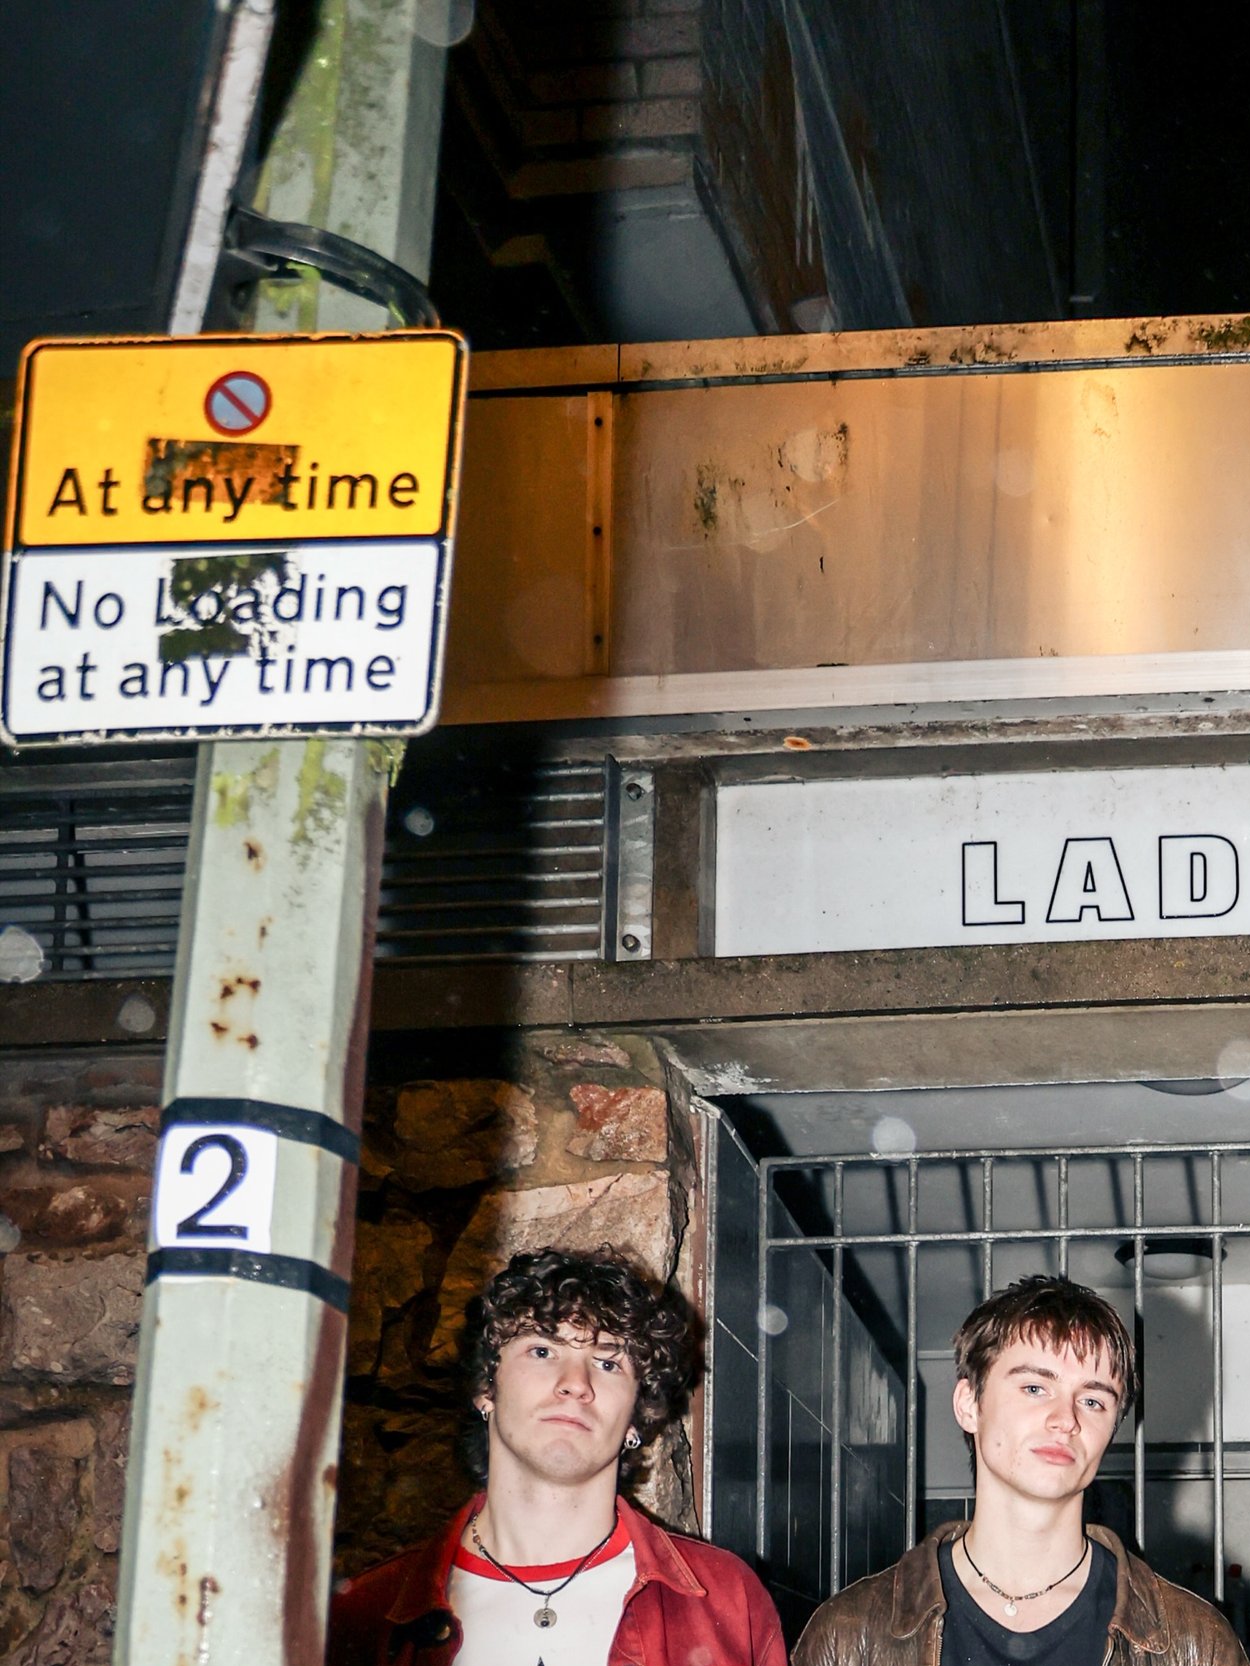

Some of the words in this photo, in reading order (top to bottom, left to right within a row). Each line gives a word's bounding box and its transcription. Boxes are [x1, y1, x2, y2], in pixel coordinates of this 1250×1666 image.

[47, 466, 119, 517] At
[141, 474, 254, 523] any
[279, 461, 419, 512] time
[40, 579, 126, 630] No
[154, 572, 408, 630] Loading
[37, 652, 97, 701] at
[119, 659, 230, 707] any
[256, 645, 396, 694] time
[176, 1133, 249, 1240] 2
